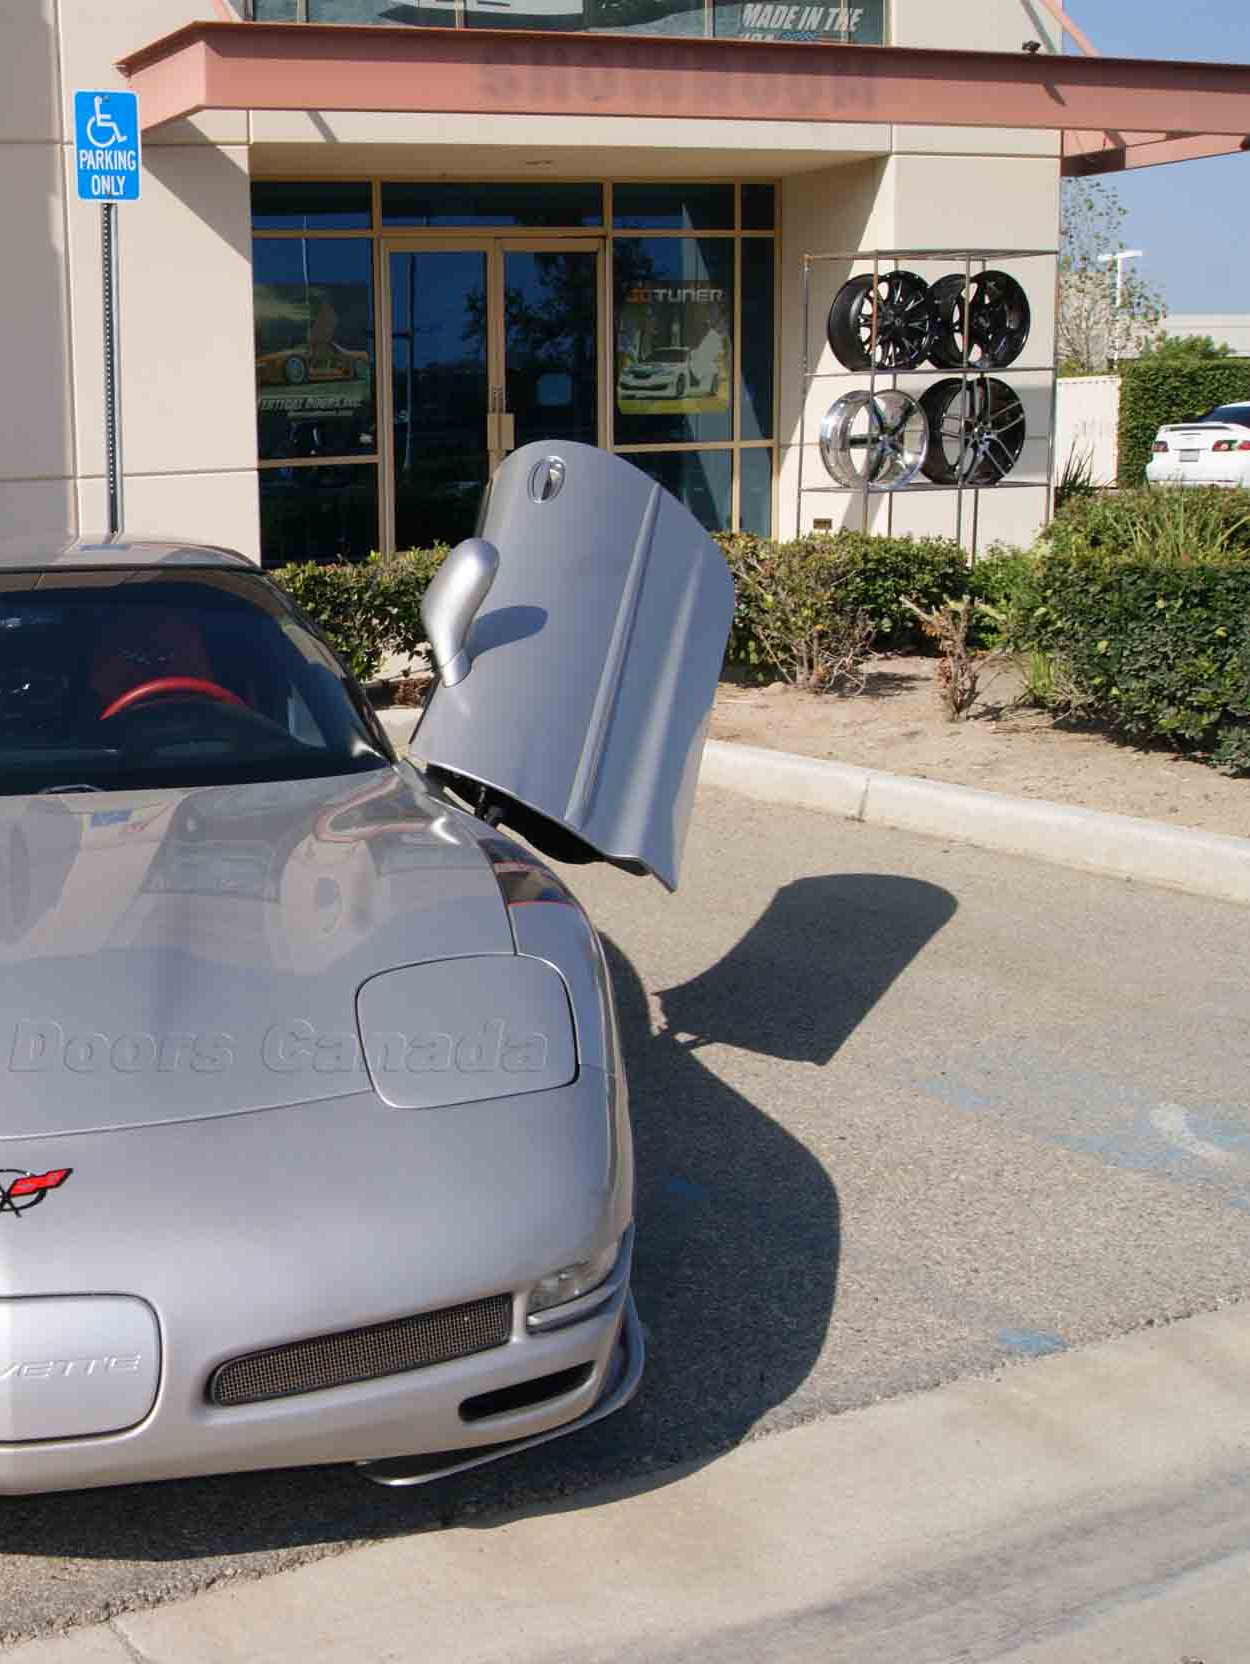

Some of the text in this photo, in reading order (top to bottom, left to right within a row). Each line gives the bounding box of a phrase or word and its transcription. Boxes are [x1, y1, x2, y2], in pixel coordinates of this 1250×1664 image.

[741, 3, 863, 32] MADE IN THE
[78, 148, 137, 171] PARKING
[91, 174, 126, 196] ONLY
